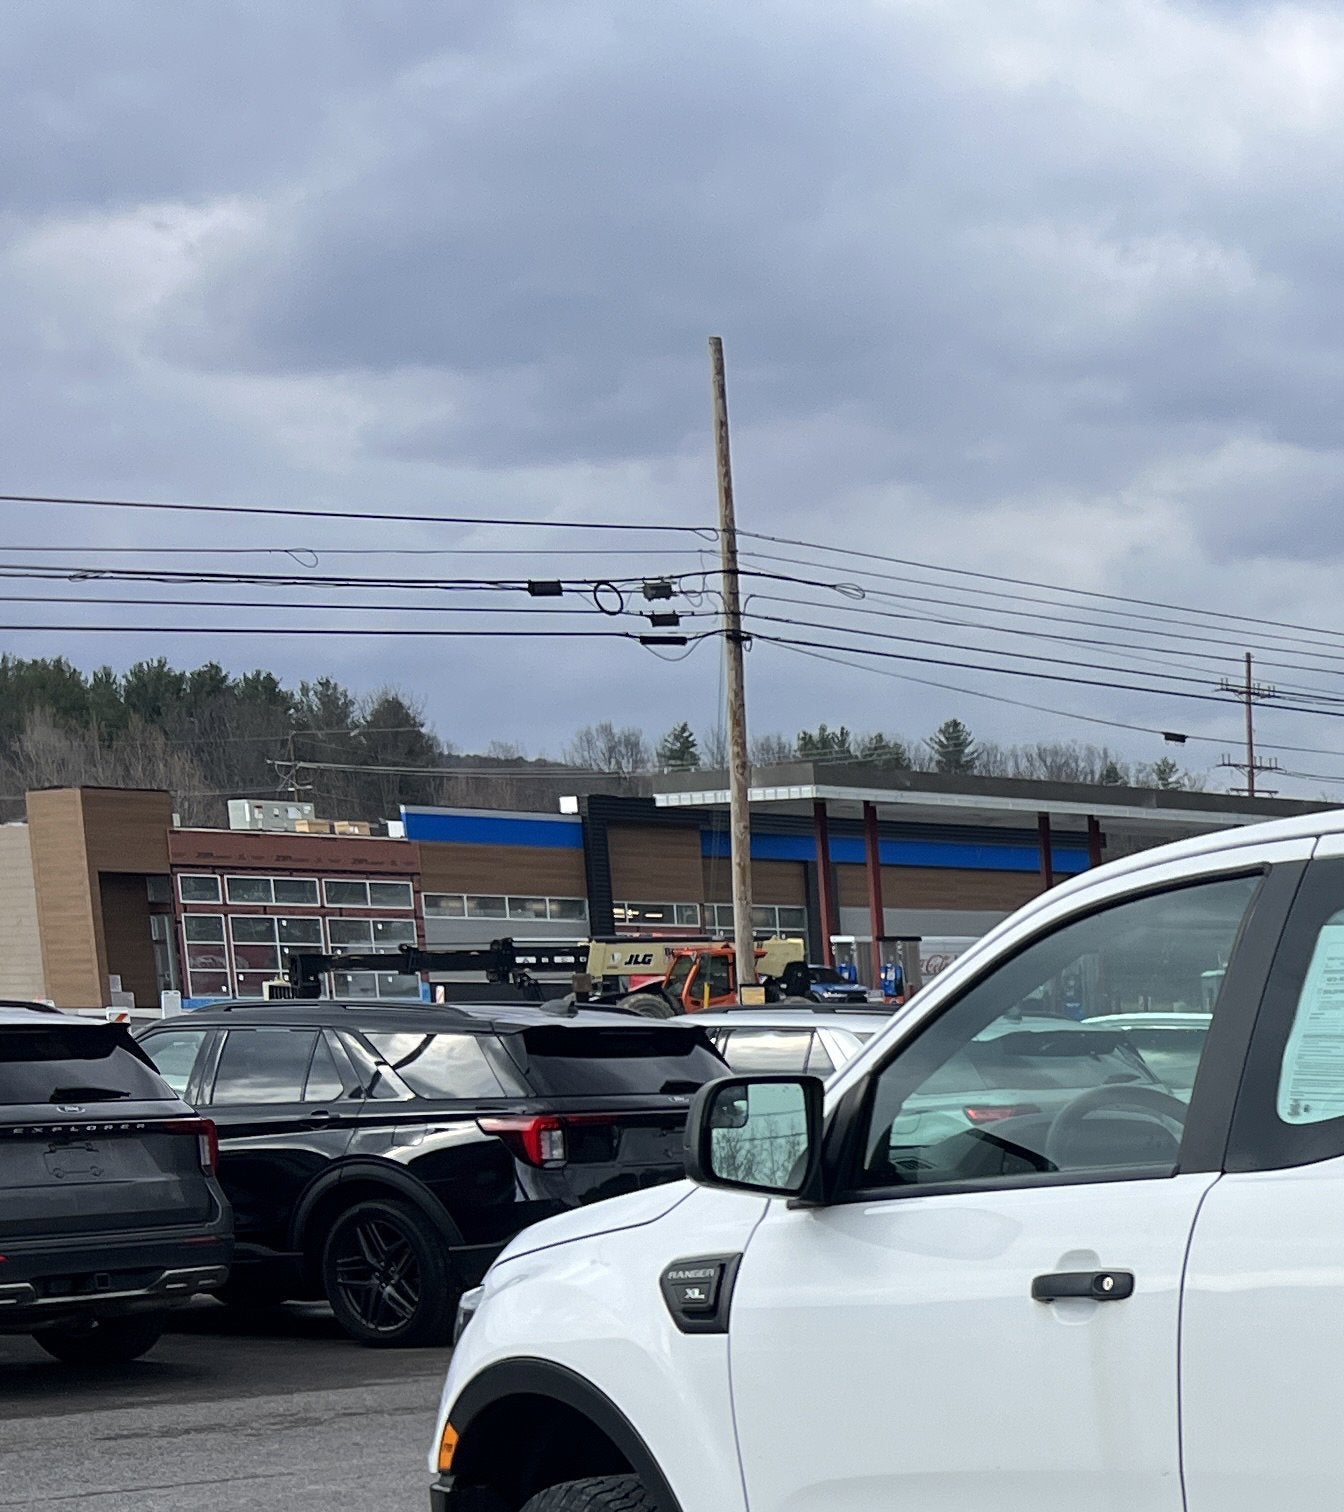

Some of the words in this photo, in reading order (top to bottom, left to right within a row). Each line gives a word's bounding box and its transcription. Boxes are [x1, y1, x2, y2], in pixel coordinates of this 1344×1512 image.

[624, 953, 653, 966] JLG
[13, 1123, 145, 1134] EXPLORER
[667, 1268, 715, 1279] RANGER
[683, 1287, 705, 1299] XL
